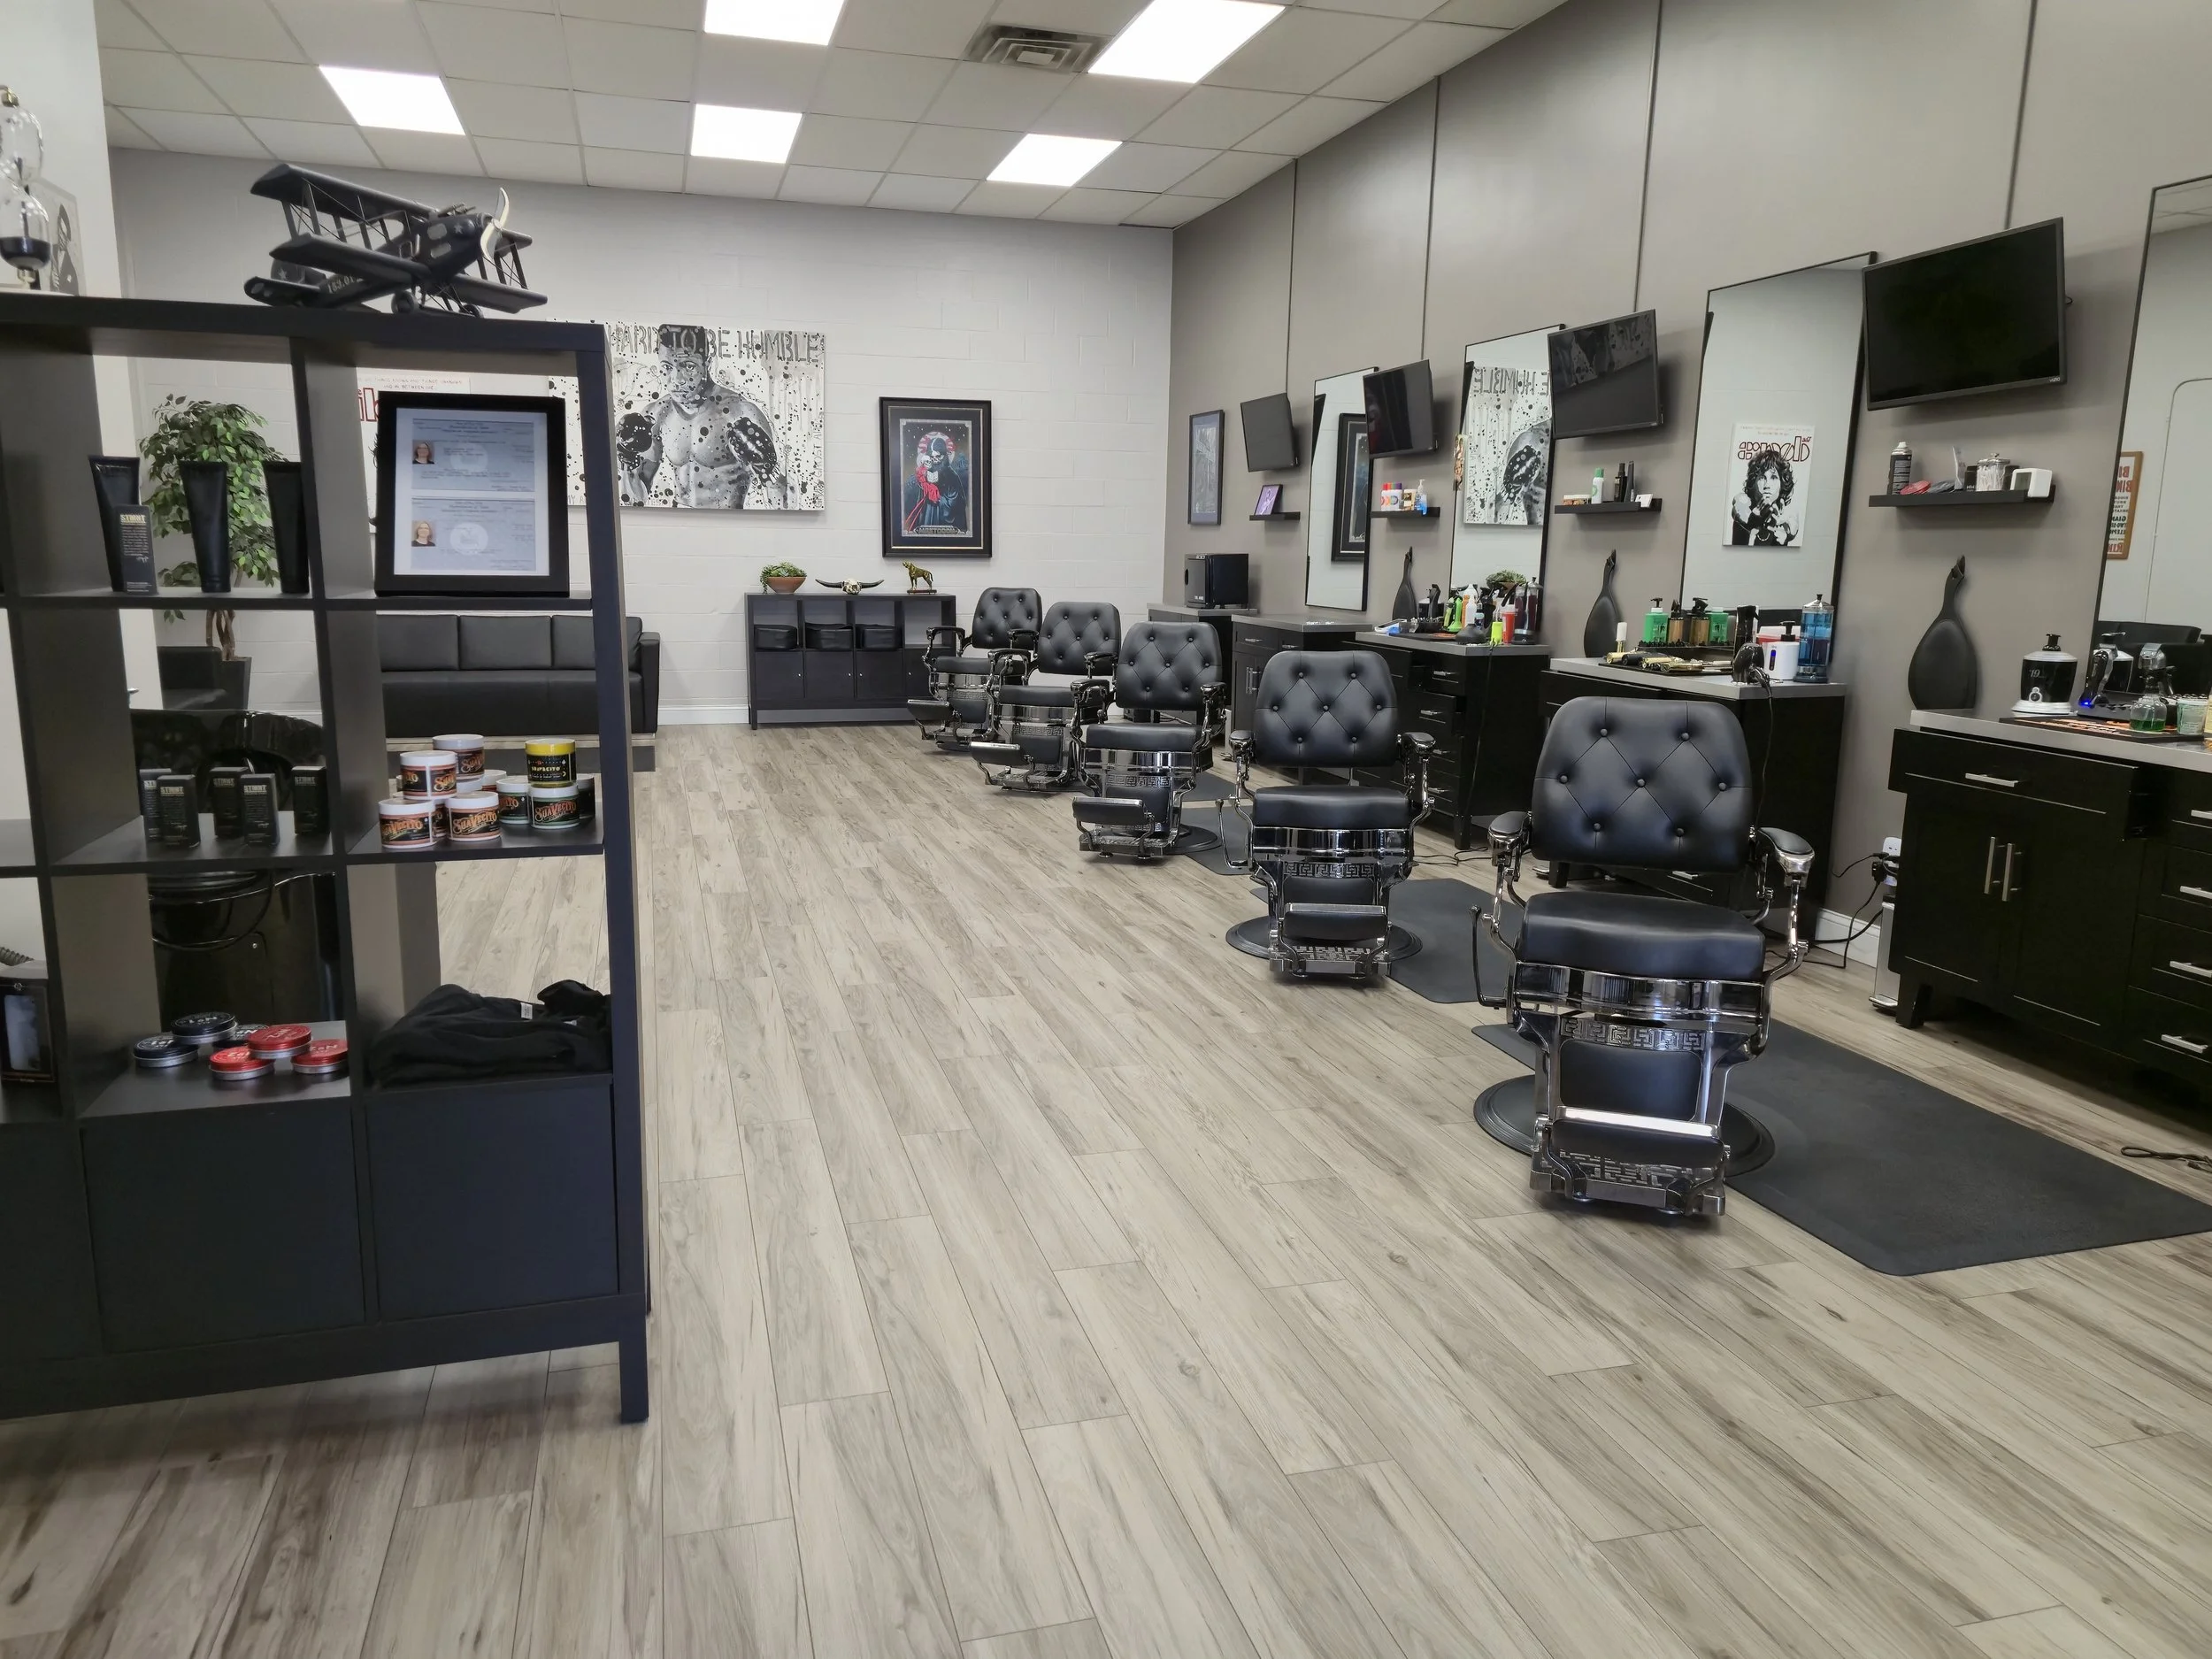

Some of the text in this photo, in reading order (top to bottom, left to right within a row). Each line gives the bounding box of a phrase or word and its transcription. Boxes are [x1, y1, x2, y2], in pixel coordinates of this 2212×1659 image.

[607, 324, 820, 364] HARD TO BE HUMBLE
[452, 809, 498, 834] SUAVECITO
